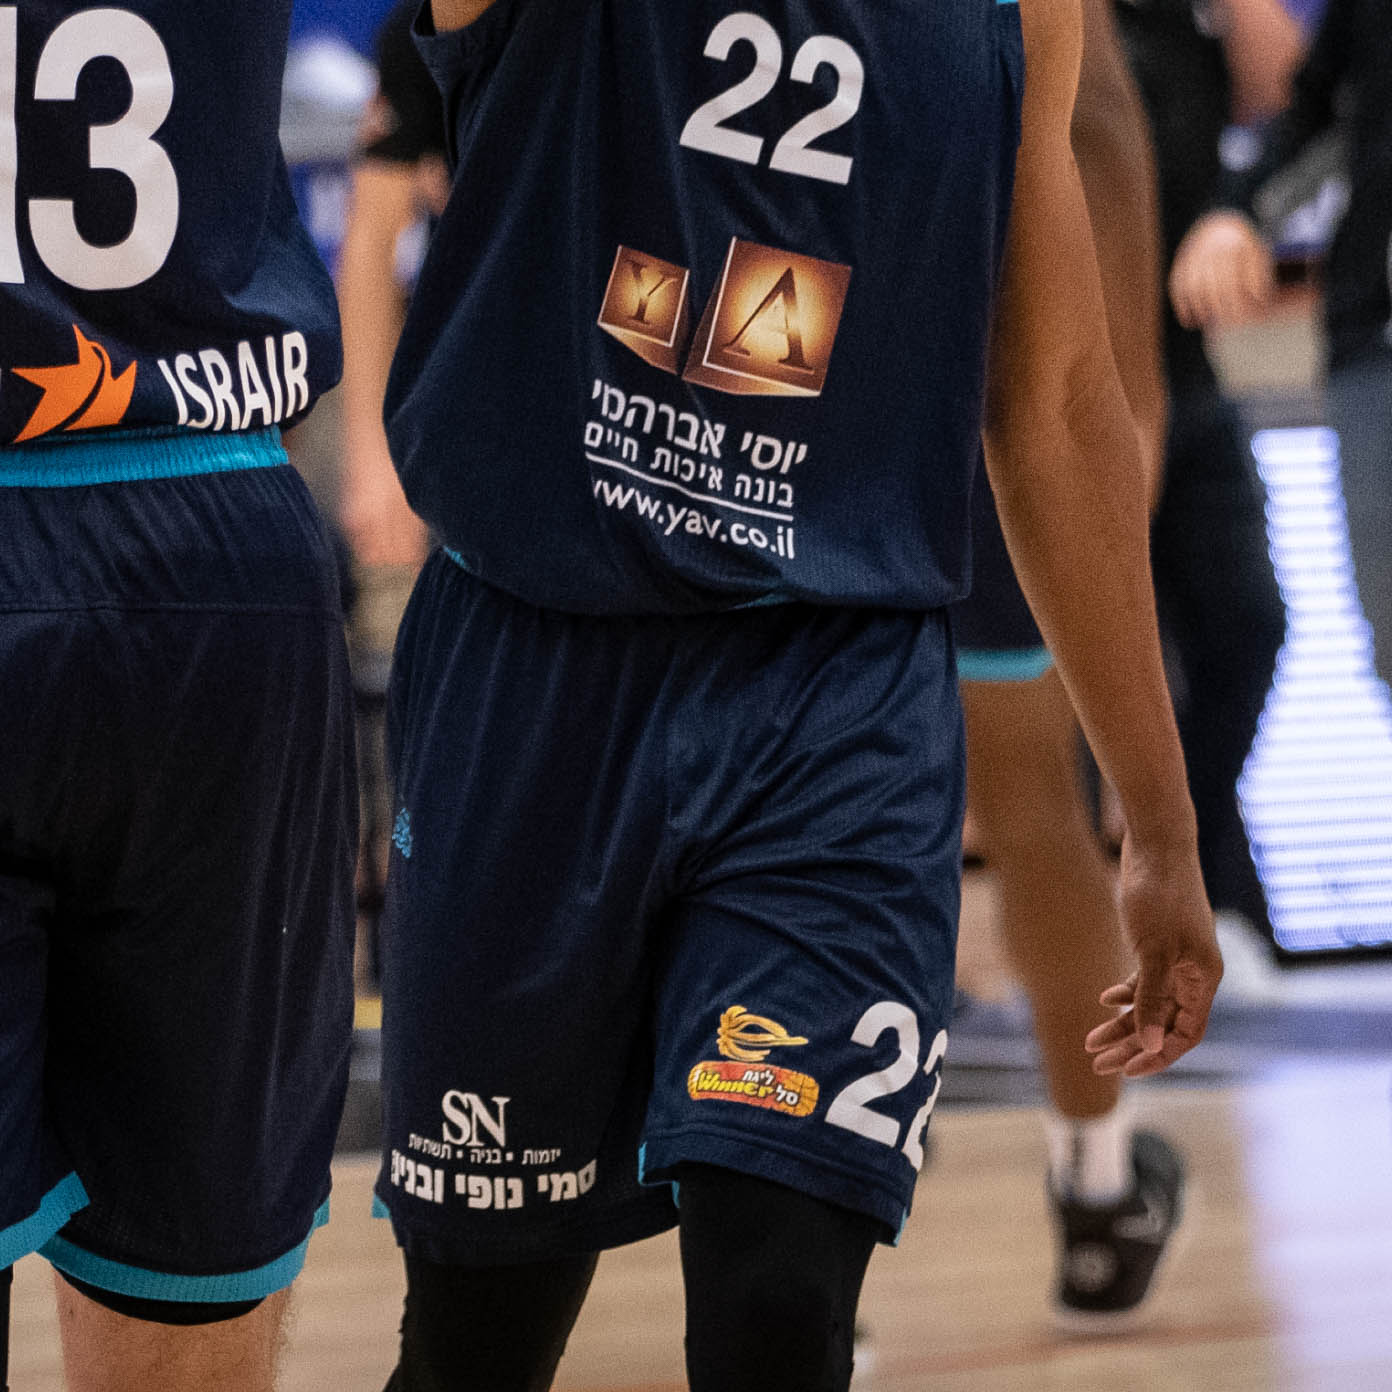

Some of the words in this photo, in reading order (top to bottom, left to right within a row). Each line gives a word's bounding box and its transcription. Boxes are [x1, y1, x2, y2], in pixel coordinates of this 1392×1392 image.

[679, 12, 865, 185] 22
[623, 259, 679, 326] Y
[721, 266, 816, 375] A
[157, 330, 309, 431] ISRAIR
[592, 379, 727, 459] אברהמי
[584, 421, 639, 462] חיים
[739, 431, 808, 474] יוסי
[649, 447, 724, 492] איכות
[734, 473, 795, 508] בונה
[696, 1071, 775, 1098] Winner
[775, 1084, 799, 1106] סל
[442, 1089, 512, 1148] SN
[470, 1148, 502, 1164] בניה
[522, 1148, 562, 1165] יזמות
[455, 1174, 524, 1210] נופי
[538, 1159, 597, 1202] סמי
